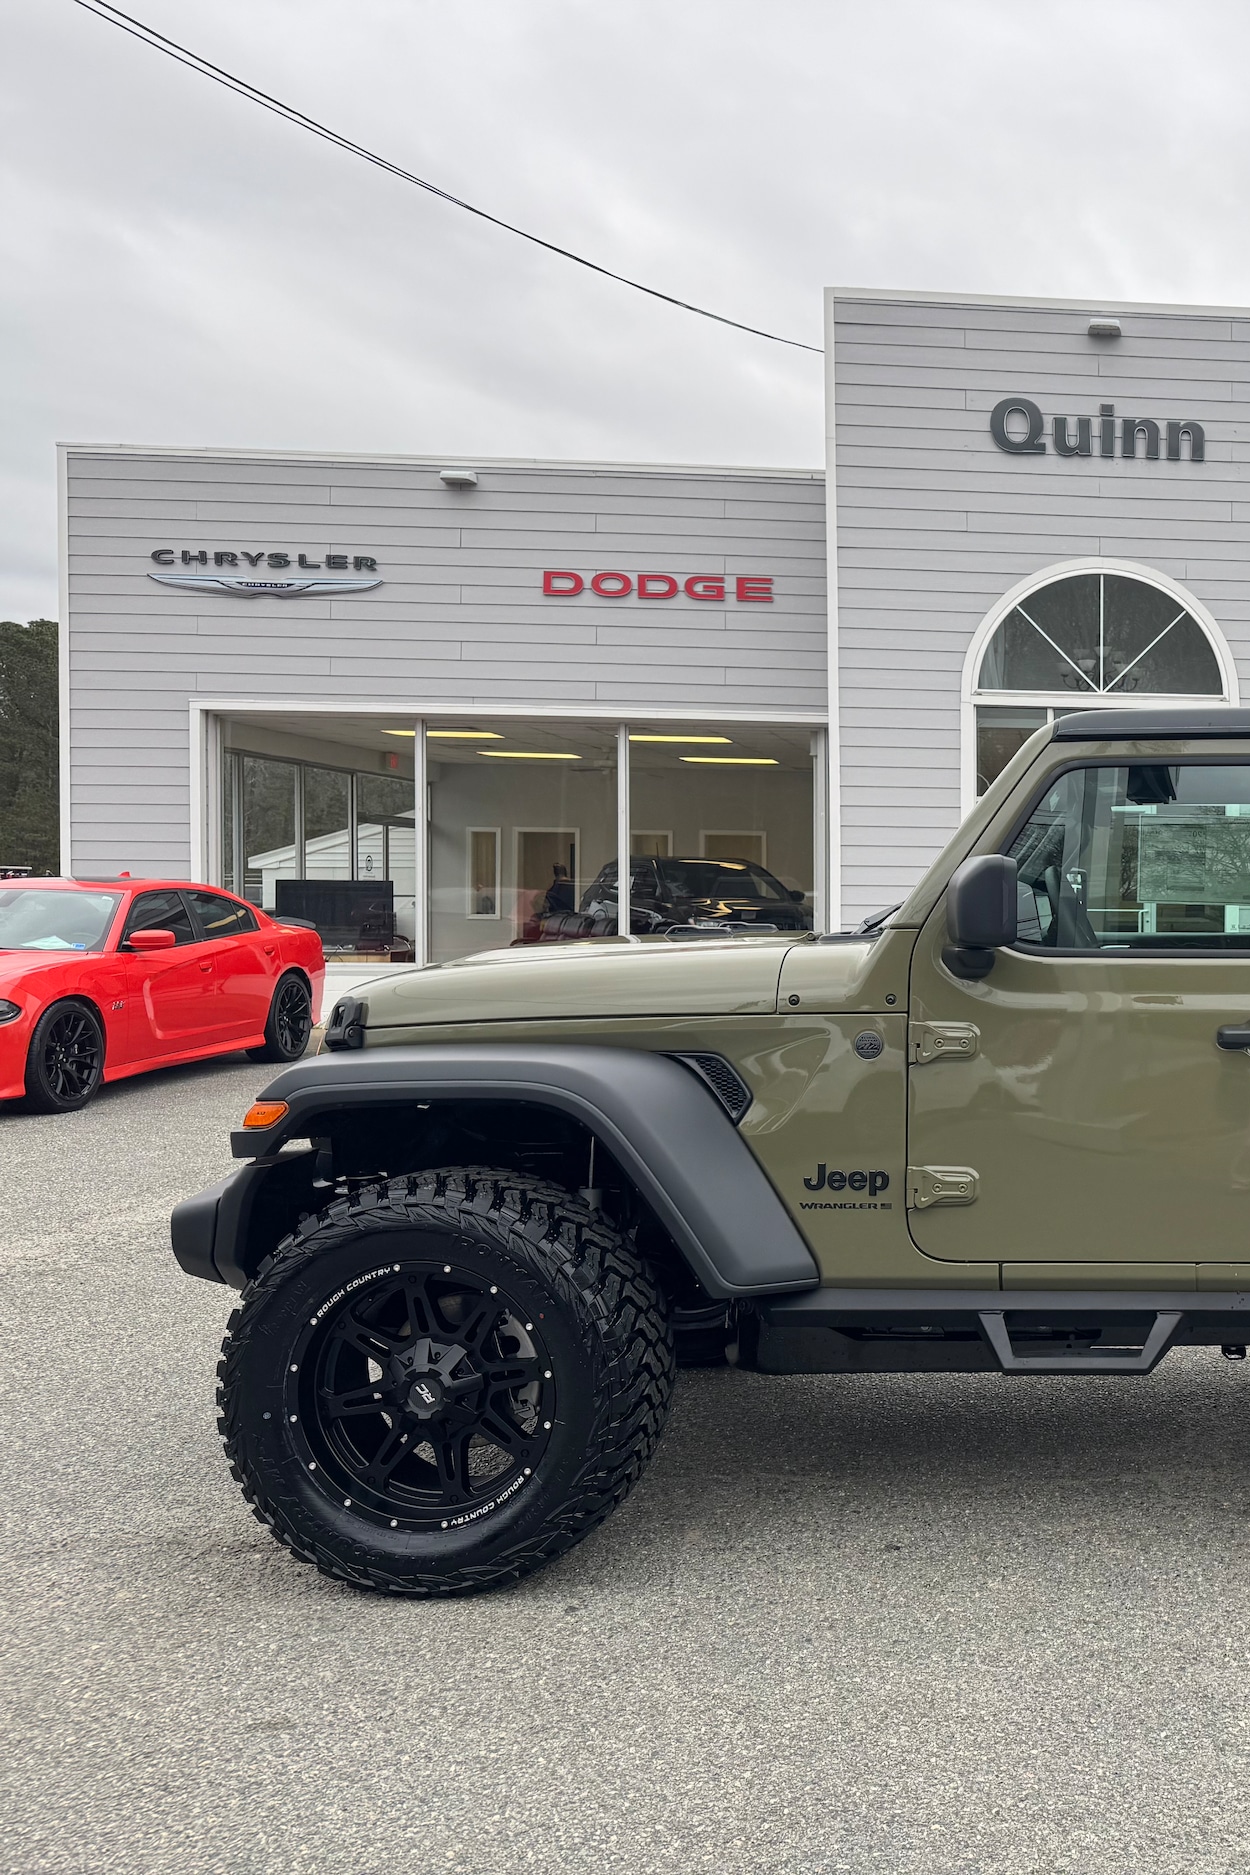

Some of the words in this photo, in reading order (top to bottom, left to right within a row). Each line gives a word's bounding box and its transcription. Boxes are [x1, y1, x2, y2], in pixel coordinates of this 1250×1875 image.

[990, 397, 1205, 461] Quinn
[150, 549, 377, 571] CHRYSLER
[543, 571, 774, 602] DODGE
[803, 1162, 890, 1196] Jeep
[799, 1202, 878, 1210] WRANGLER
[317, 1289, 345, 1318] ROUGH
[346, 1267, 391, 1291] COUNTRY
[415, 1383, 436, 1404] RC
[496, 1475, 525, 1504] ROUGH
[450, 1501, 496, 1526] COUNTRY
